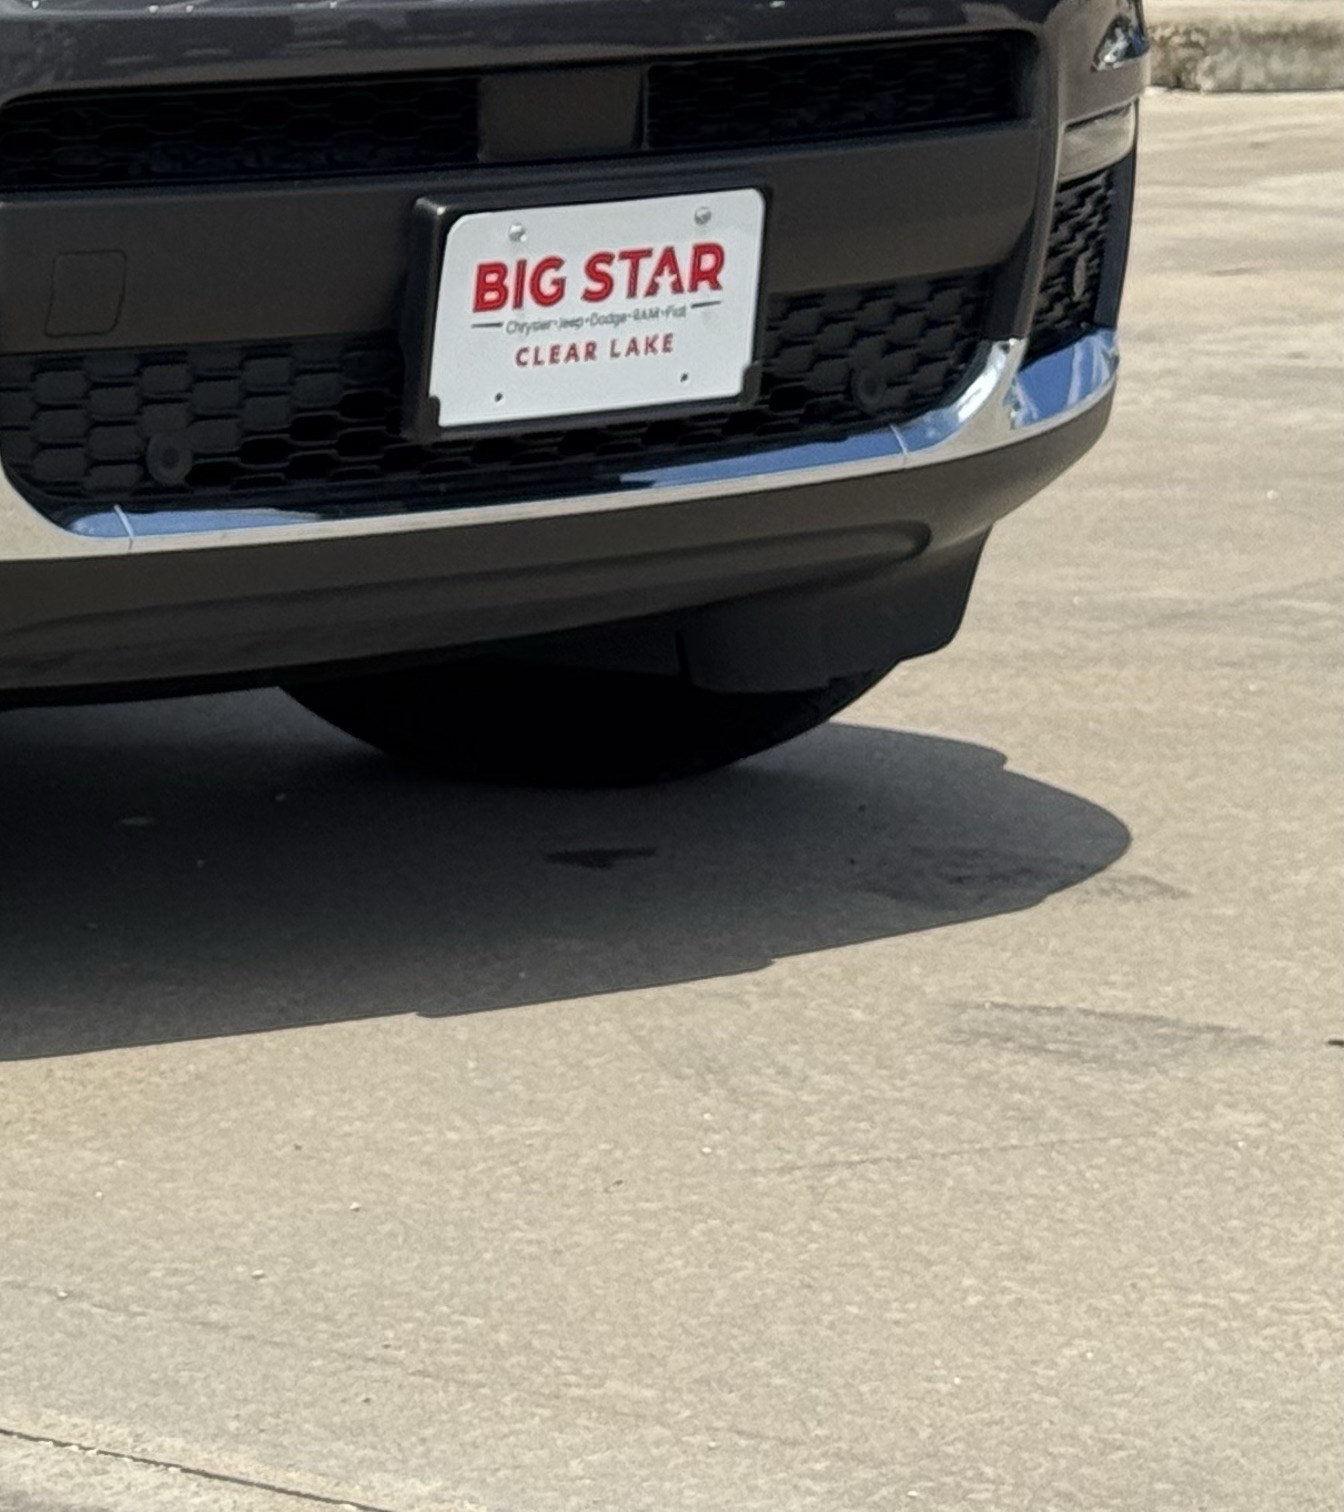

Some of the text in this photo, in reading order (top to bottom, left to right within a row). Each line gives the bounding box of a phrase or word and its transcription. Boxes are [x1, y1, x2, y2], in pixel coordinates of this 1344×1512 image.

[472, 242, 726, 313] BIG STAR
[515, 333, 675, 367] CLEAR LAKE
